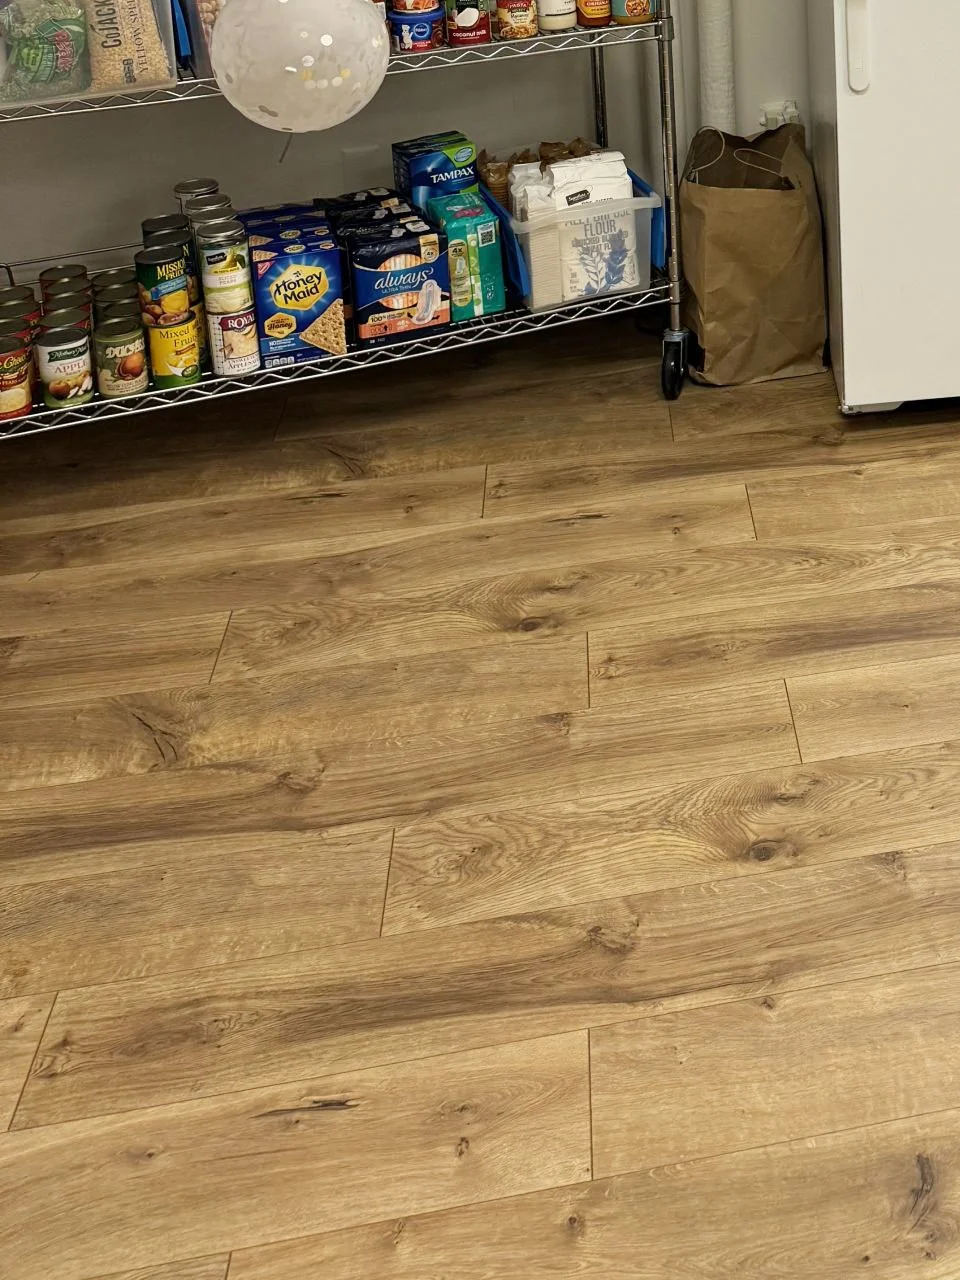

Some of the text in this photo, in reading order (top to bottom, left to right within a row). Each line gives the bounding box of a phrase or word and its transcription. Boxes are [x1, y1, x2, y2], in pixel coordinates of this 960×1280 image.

[453, 30, 476, 38] coconut
[430, 165, 475, 184] TAMPAX
[584, 220, 617, 238] FLOUR
[274, 272, 322, 299] Honey
[374, 267, 434, 290] always
[283, 284, 320, 304] Maid
[159, 326, 190, 339] Mixed
[267, 321, 293, 331] Honey
[54, 360, 87, 373] APPLE
